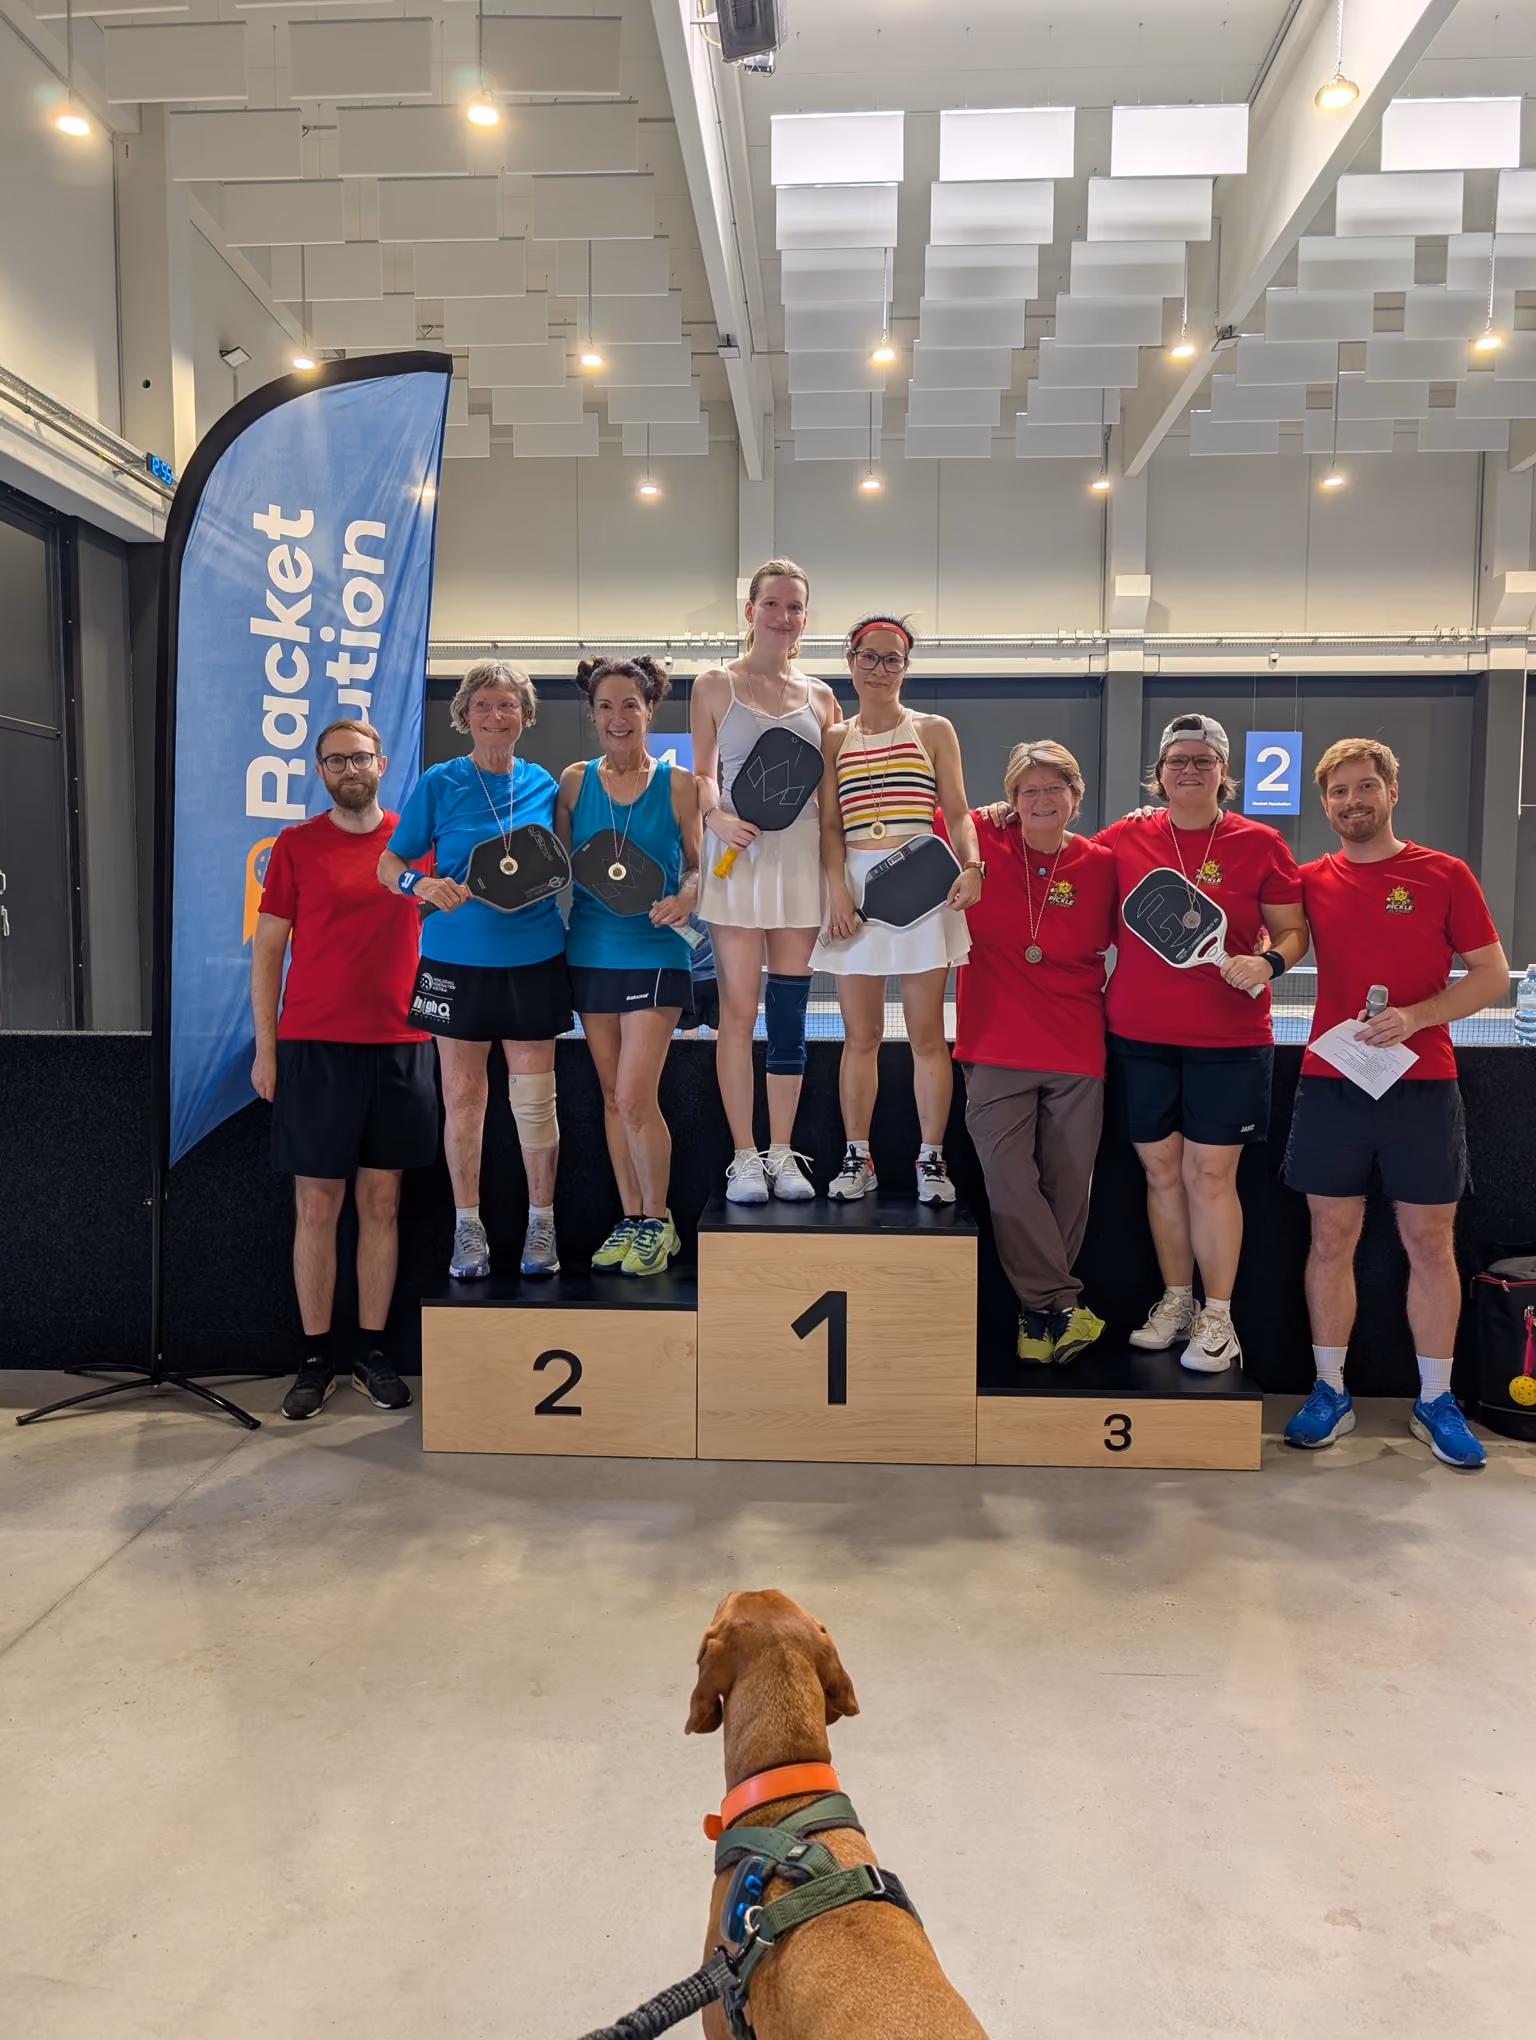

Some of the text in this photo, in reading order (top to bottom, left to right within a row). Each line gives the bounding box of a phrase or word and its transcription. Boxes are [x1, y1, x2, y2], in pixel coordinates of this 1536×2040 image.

[245, 504, 315, 820] Racket
[319, 519, 386, 724] ution
[1256, 746, 1290, 792] 2
[532, 1348, 583, 1416] 2
[790, 1290, 848, 1406] 1
[1103, 1413, 1133, 1453] 3
